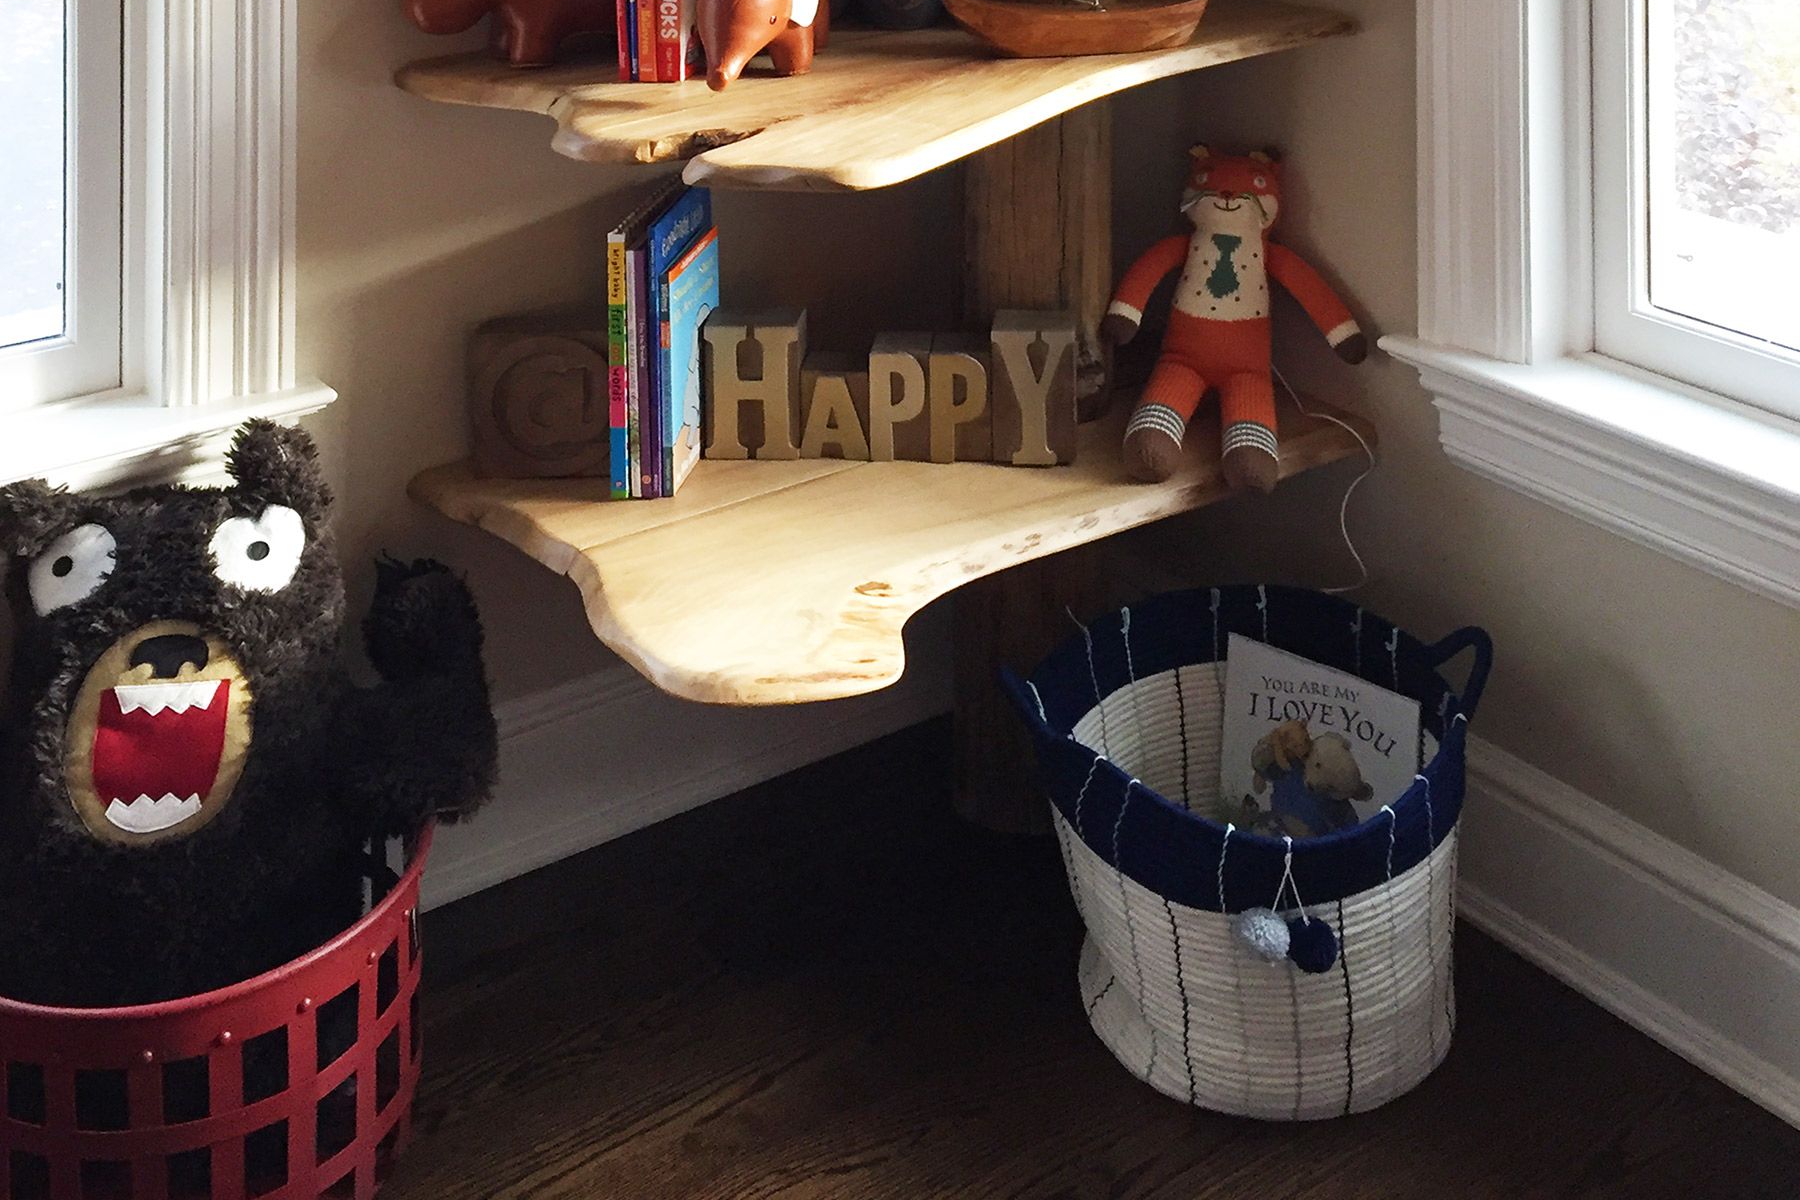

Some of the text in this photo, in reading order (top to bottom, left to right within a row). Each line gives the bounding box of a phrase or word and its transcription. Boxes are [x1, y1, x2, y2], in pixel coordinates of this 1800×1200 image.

[611, 248, 621, 299] bright baby
[611, 308, 623, 336] first
[612, 368, 622, 402] words
[1262, 675, 1360, 703] YOU ARE MY
[1249, 692, 1397, 760] I LOVE YOU
